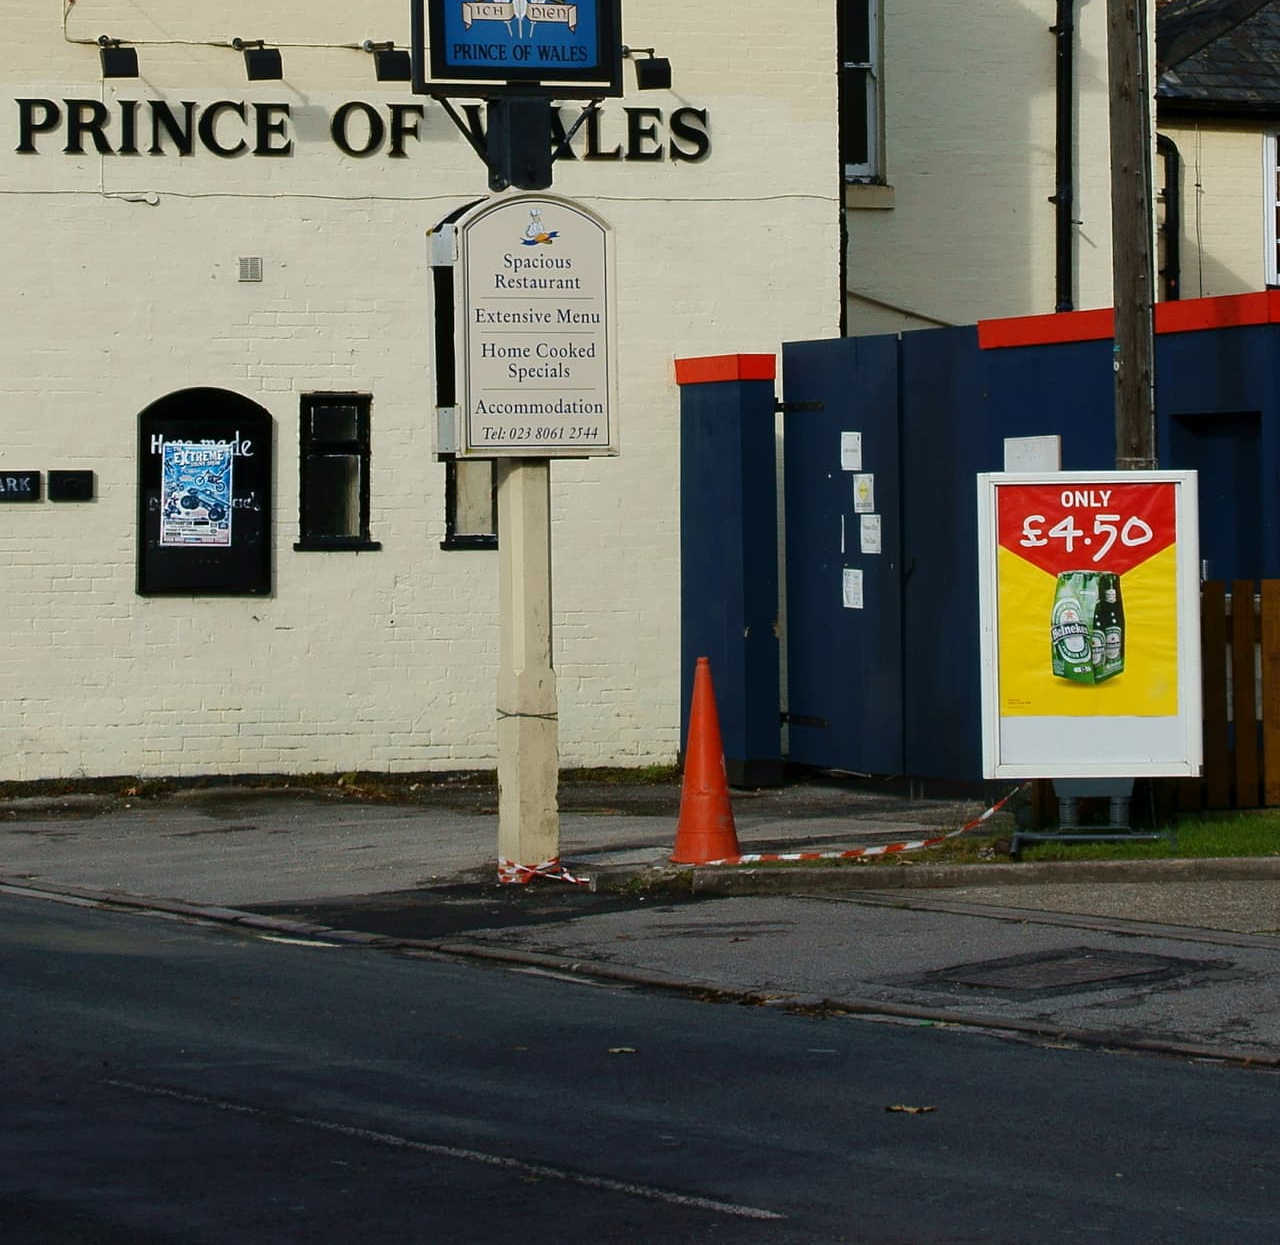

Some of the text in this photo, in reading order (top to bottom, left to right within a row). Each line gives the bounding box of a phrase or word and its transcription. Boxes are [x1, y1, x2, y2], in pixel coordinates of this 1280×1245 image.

[476, 5, 503, 16] ICH
[453, 44, 588, 62] PRINCE OF WALES
[14, 98, 293, 157] PRINCE
[329, 100, 424, 157] OF
[504, 253, 572, 272] Spacious
[495, 274, 581, 289] Restaurant
[476, 308, 600, 324] Extensive Menu
[482, 342, 595, 358] Home Cooked
[508, 363, 570, 382] Specials
[476, 400, 603, 414] Accommodation
[482, 427, 598, 440] Tel: 023 8061 2544
[174, 450, 224, 465] EXTREME
[1061, 490, 1112, 507] ONLY
[1019, 513, 1154, 562] £4.50
